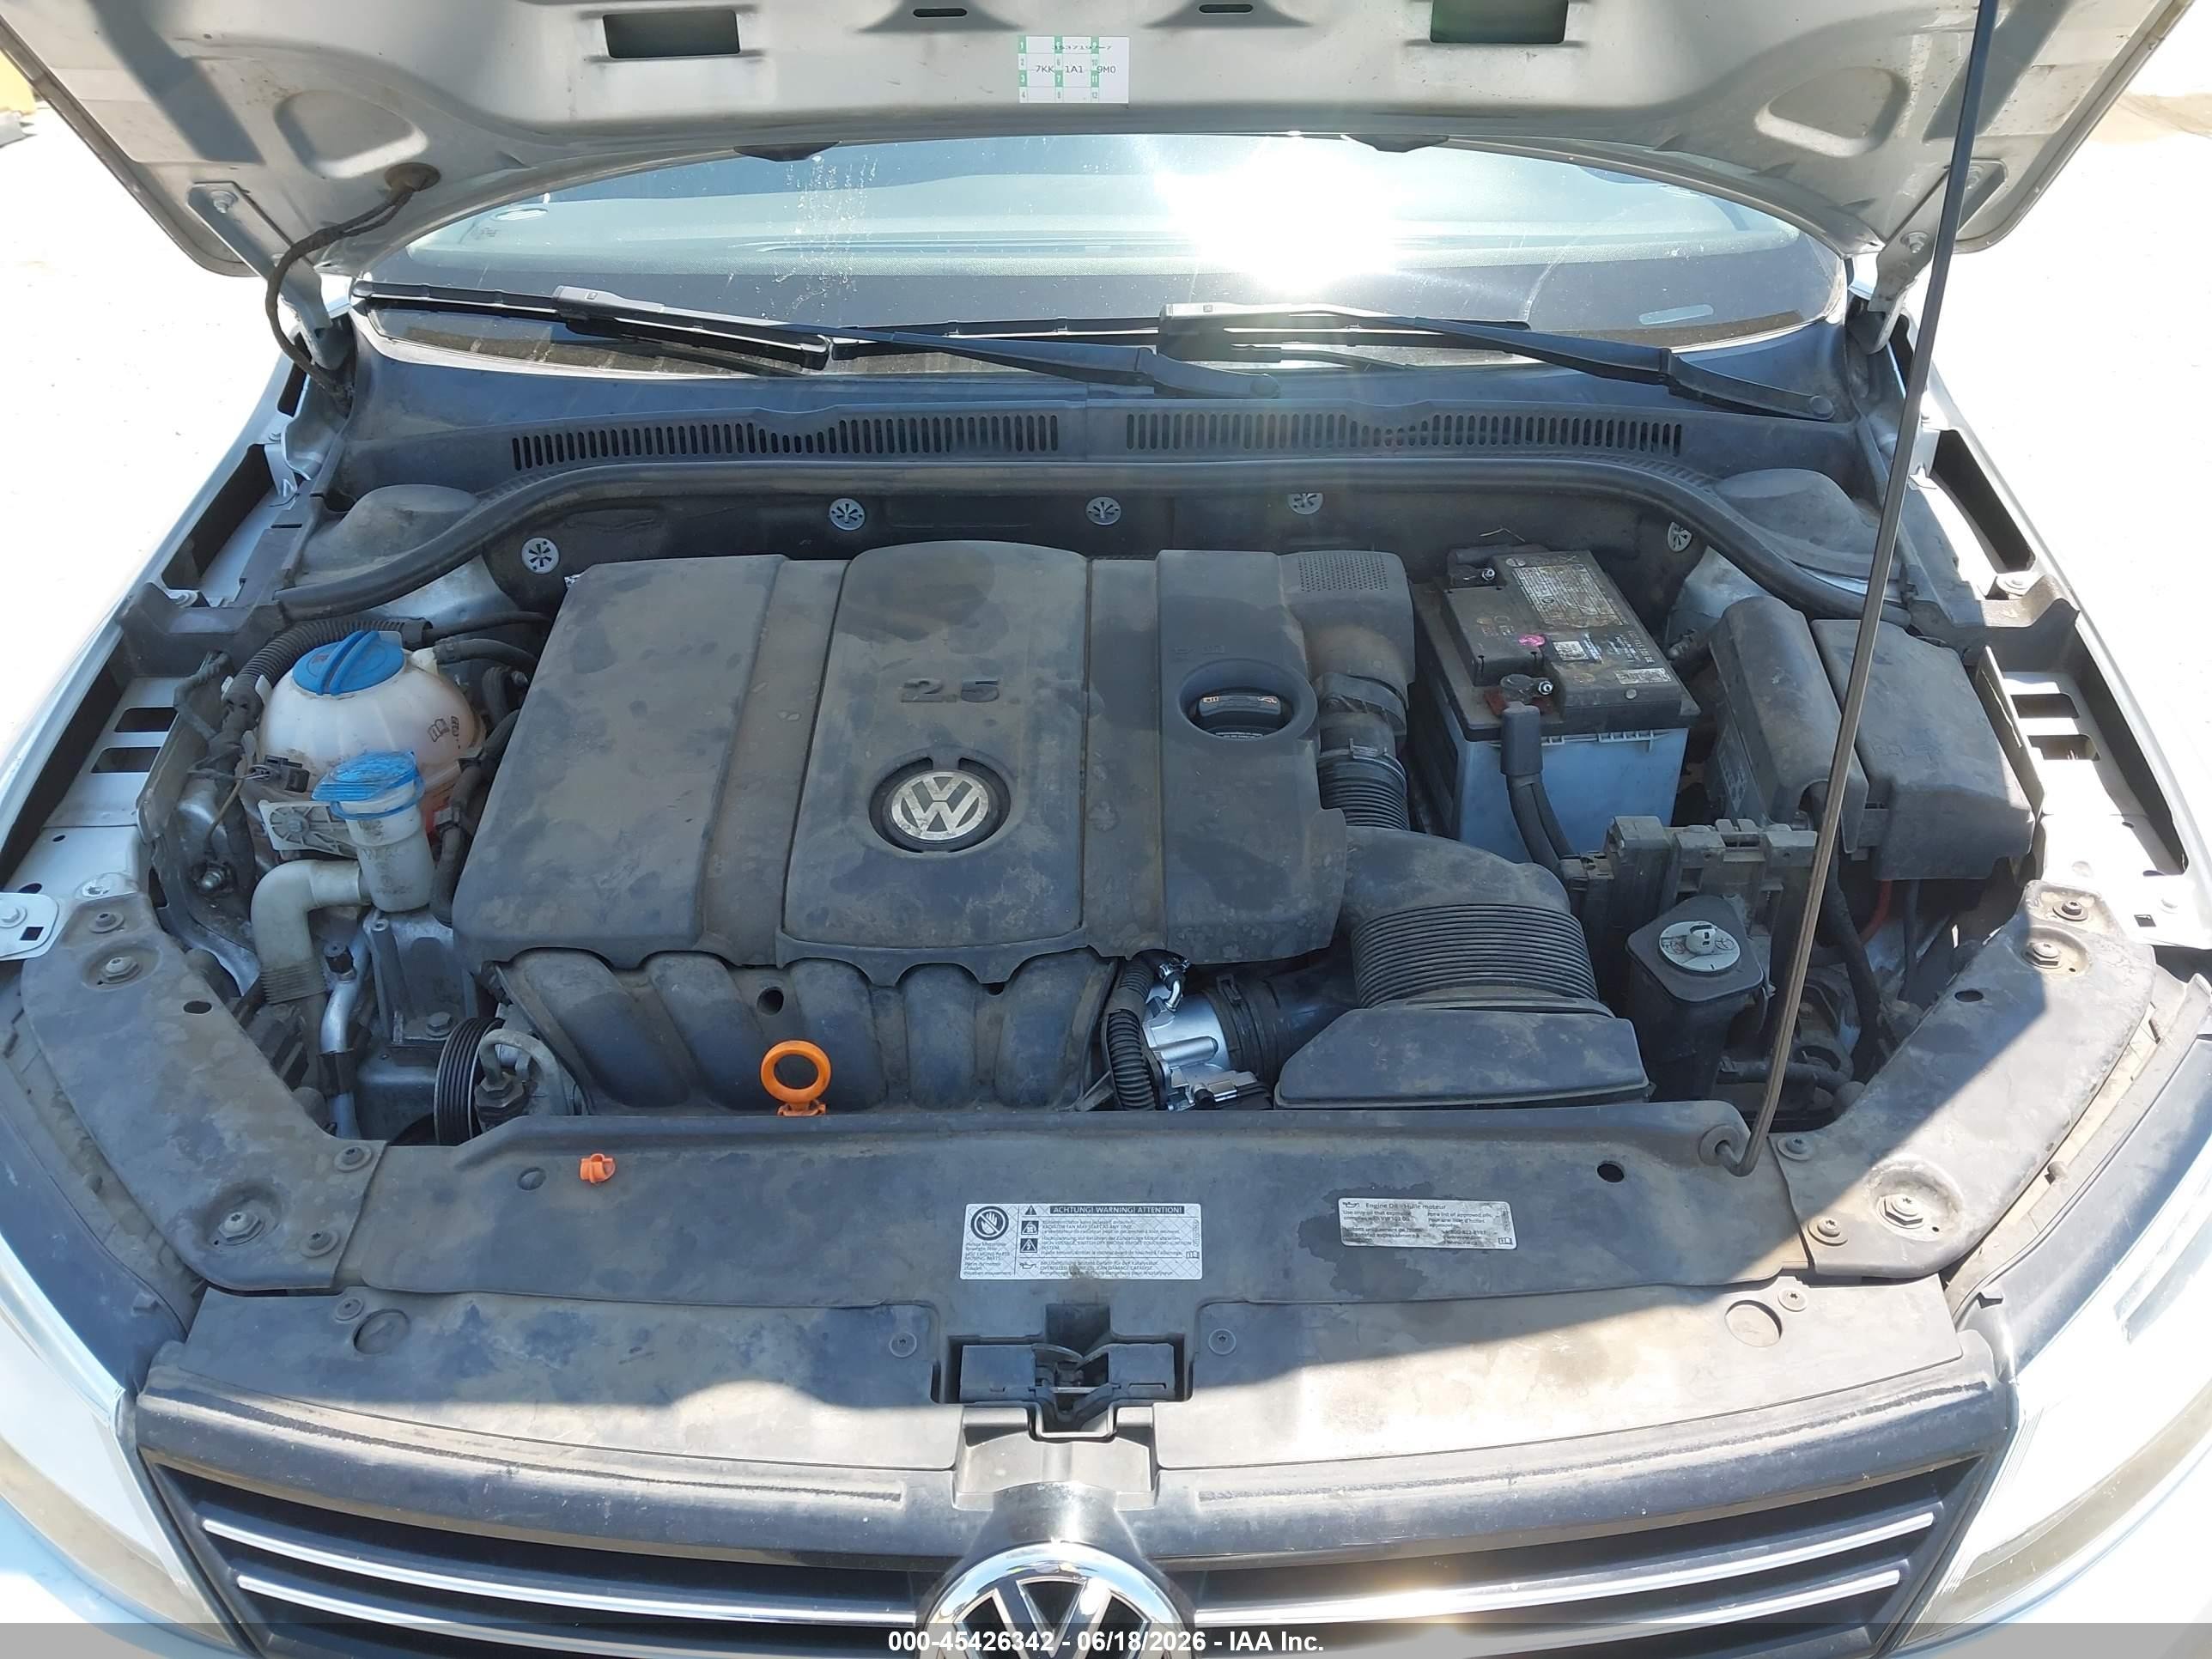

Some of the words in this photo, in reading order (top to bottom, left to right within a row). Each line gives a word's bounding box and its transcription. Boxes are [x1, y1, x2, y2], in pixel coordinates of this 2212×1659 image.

[1035, 64, 1054, 74] 7KK
[1065, 64, 1084, 74] 1A1
[901, 676, 1000, 703] 2.5
[891, 771, 989, 842] VW
[1053, 1206, 1094, 1214] ACHTUNG!
[1096, 1206, 1136, 1214] WARNING!
[1137, 1206, 1182, 1214] ATTENTION!
